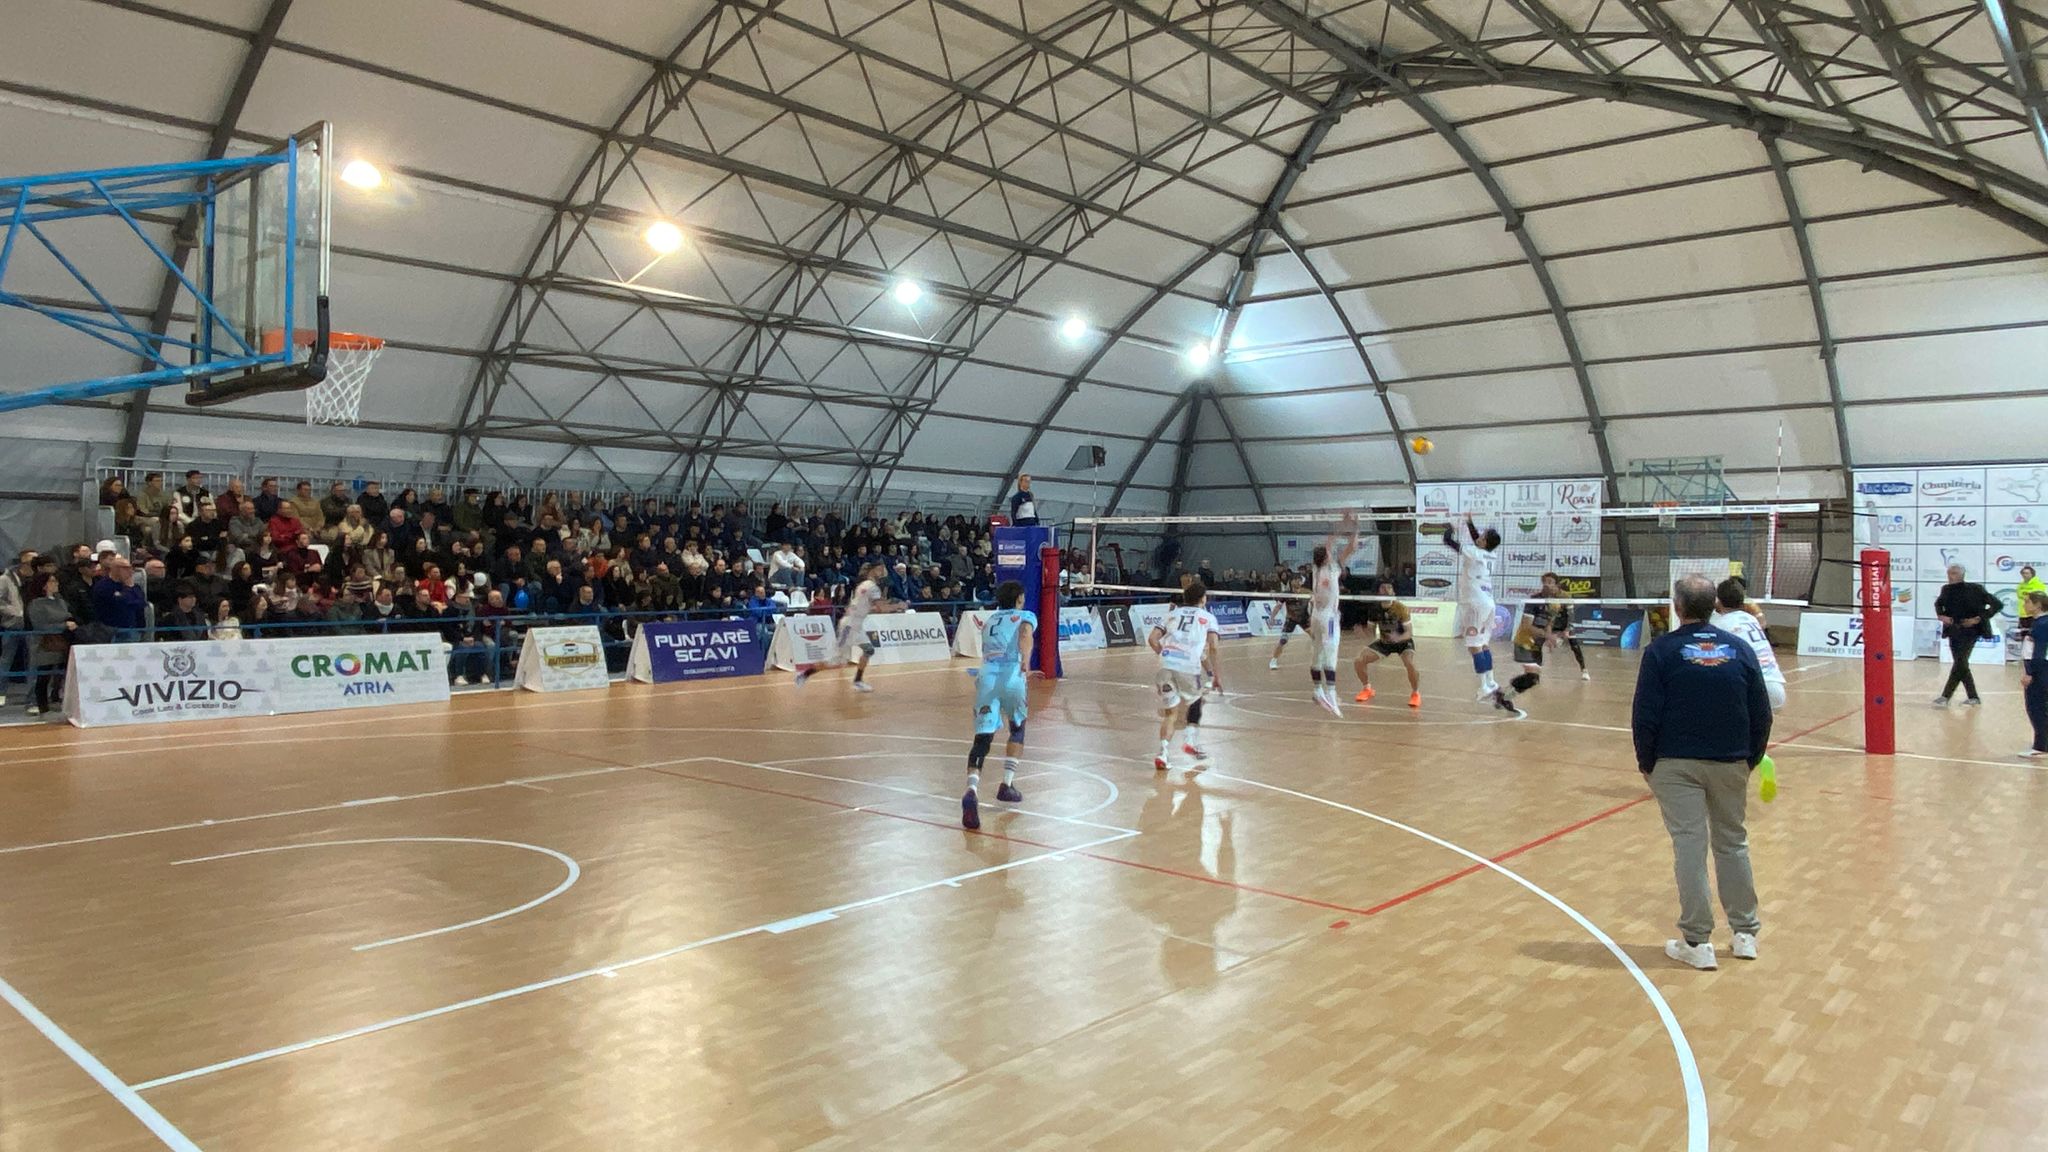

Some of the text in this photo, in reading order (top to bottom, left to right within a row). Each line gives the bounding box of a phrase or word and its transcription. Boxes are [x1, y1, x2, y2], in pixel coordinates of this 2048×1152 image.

[989, 617, 1003, 637] 2
[1177, 615, 1195, 633] 12
[880, 628, 945, 642] SICILBANCA
[1826, 631, 1864, 647] SIA
[675, 646, 738, 663] SCAVI
[291, 650, 431, 678] CROMAT
[117, 680, 243, 707] VIVIZIO
[344, 681, 395, 696] ATRIA
[222, 701, 238, 710] Bar
